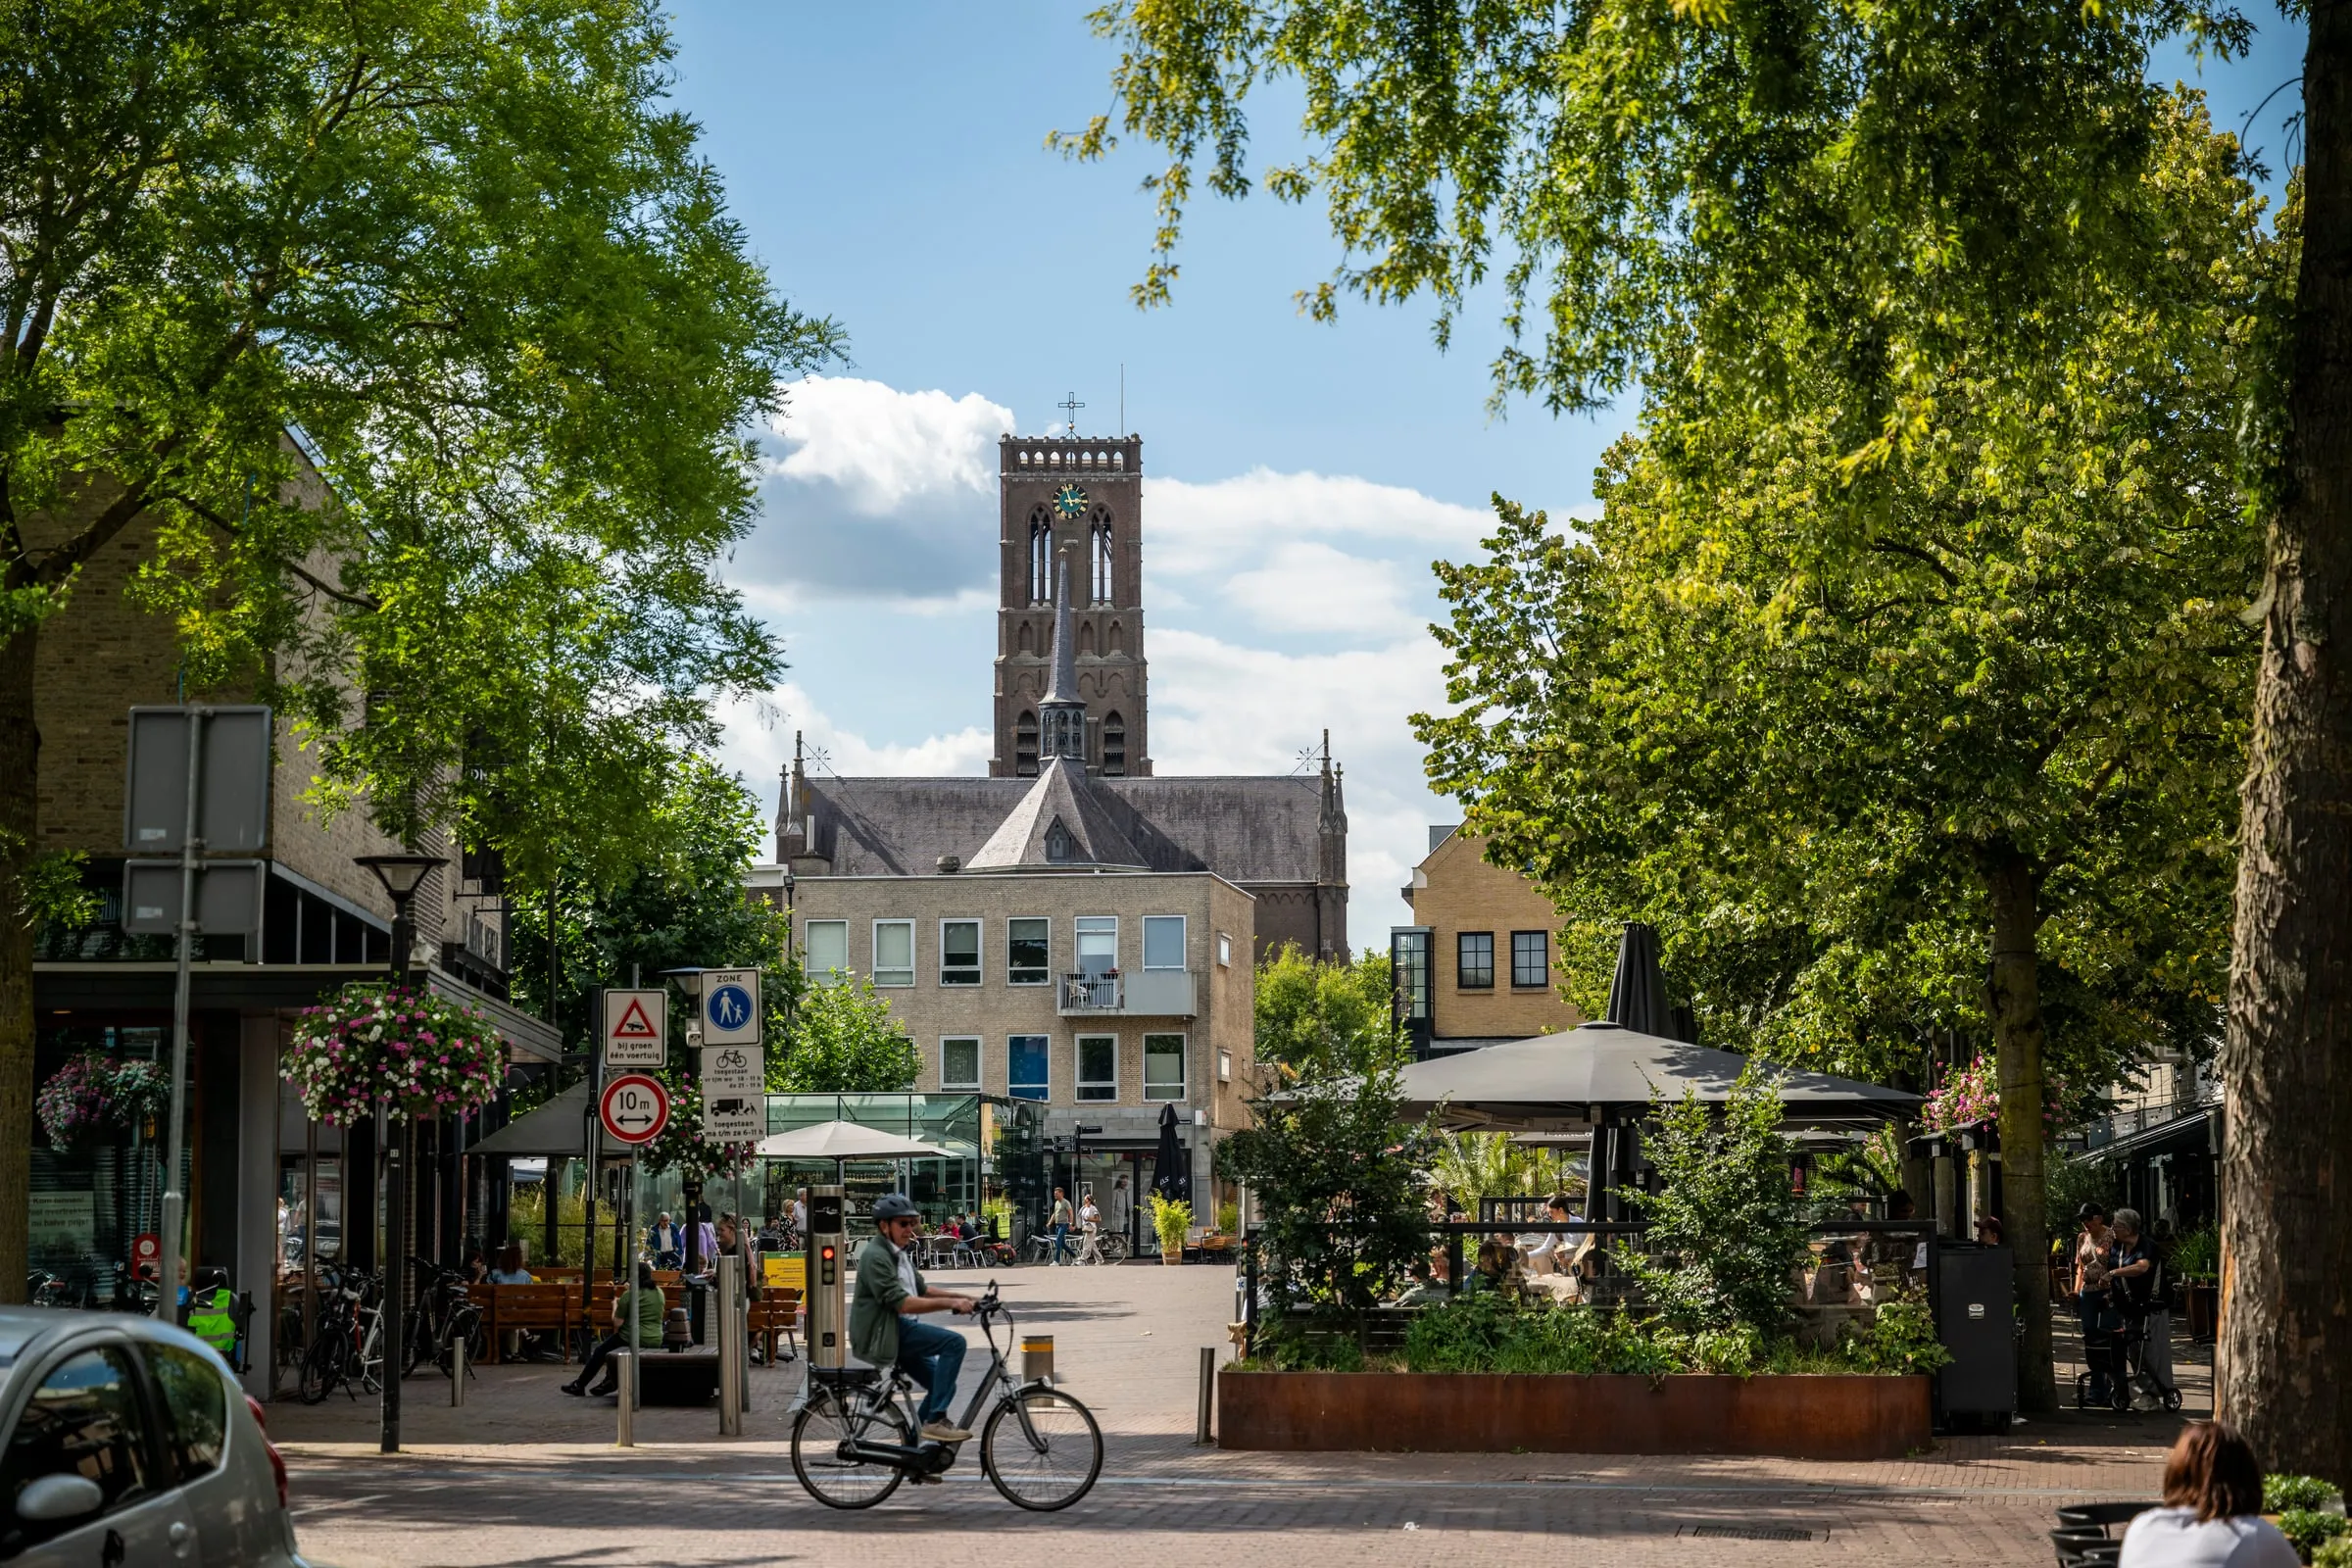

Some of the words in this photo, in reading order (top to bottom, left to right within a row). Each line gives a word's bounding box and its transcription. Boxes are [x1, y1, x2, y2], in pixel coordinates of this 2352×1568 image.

[716, 974, 743, 983] ZONE
[617, 1042, 628, 1052] bij
[627, 1052, 660, 1061] voertuig
[619, 1091, 637, 1110] 10
[640, 1101, 650, 1110] m
